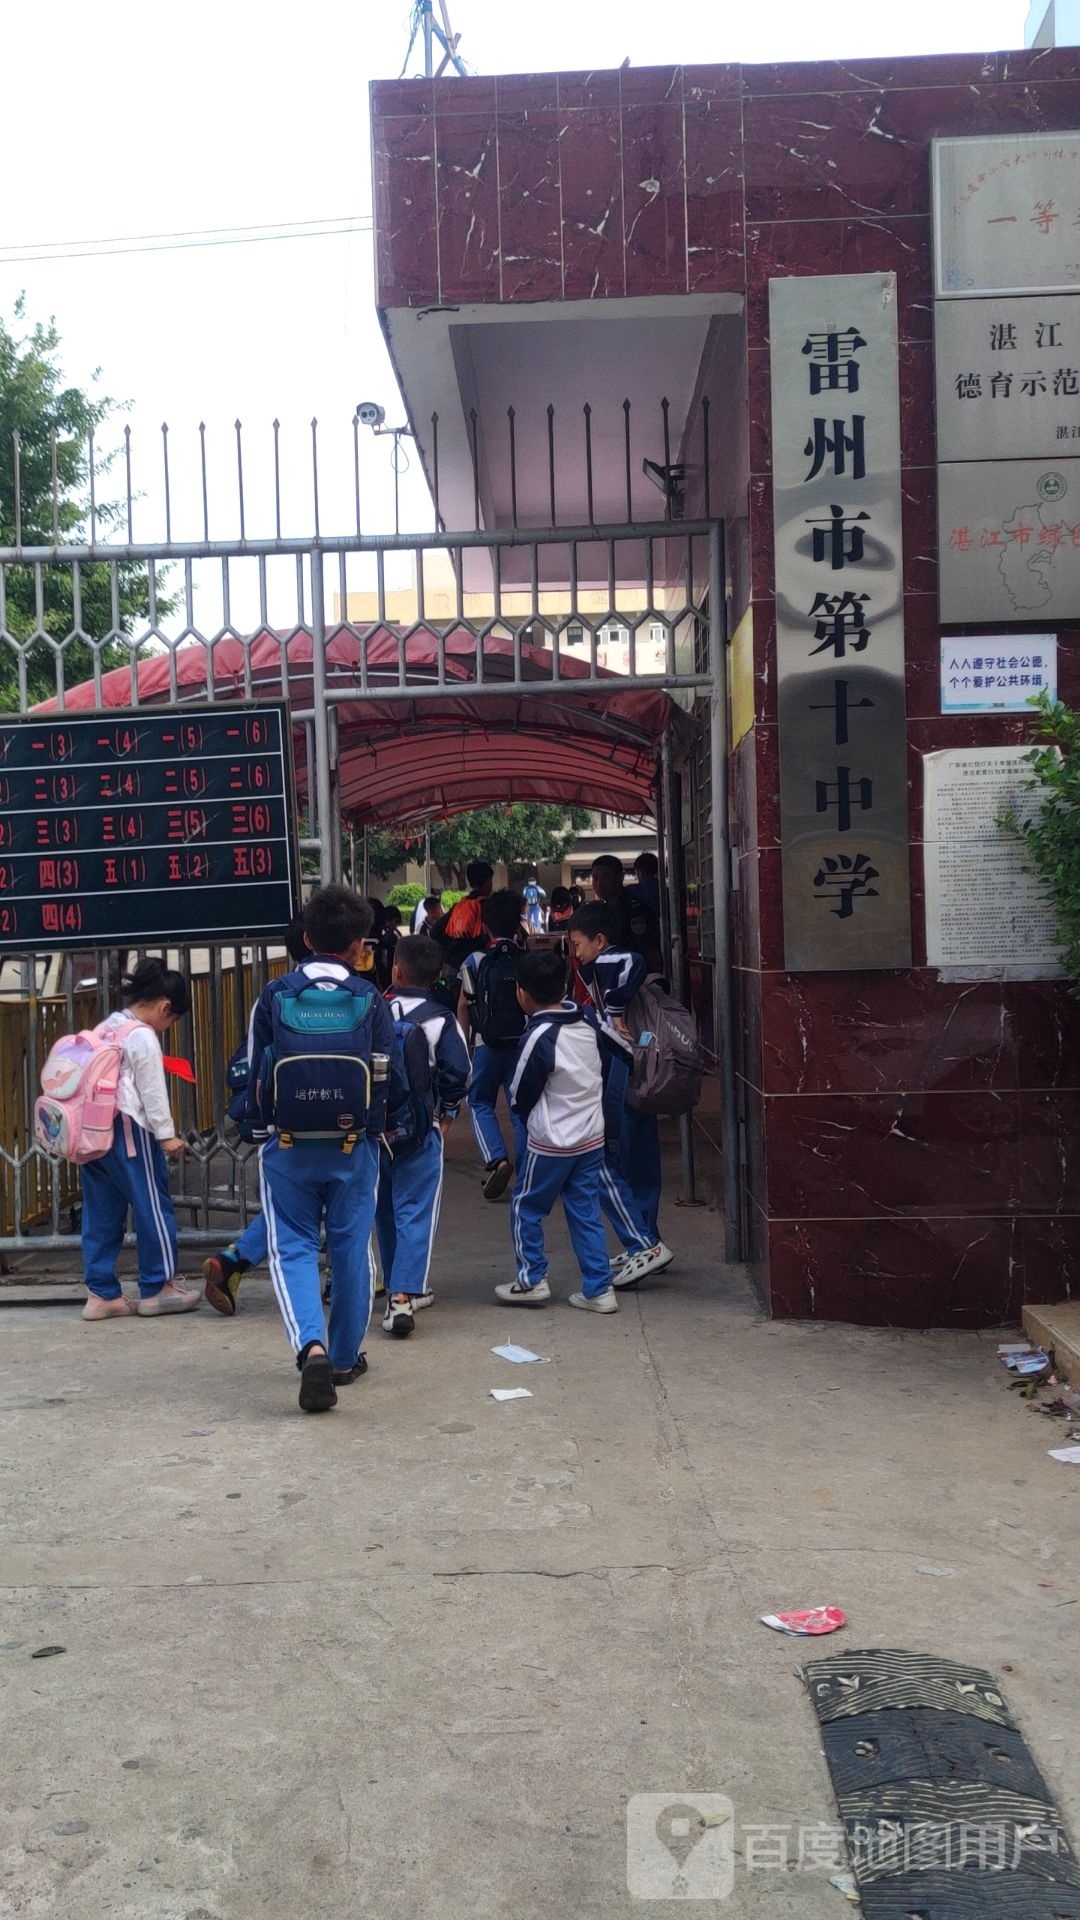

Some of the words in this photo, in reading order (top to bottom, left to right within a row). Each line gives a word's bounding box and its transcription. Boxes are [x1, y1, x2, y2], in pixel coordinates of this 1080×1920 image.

[990, 322, 1063, 350] 湛江
[954, 368, 1079, 399] 德育示范
[801, 326, 881, 919] 雷州市第十中学
